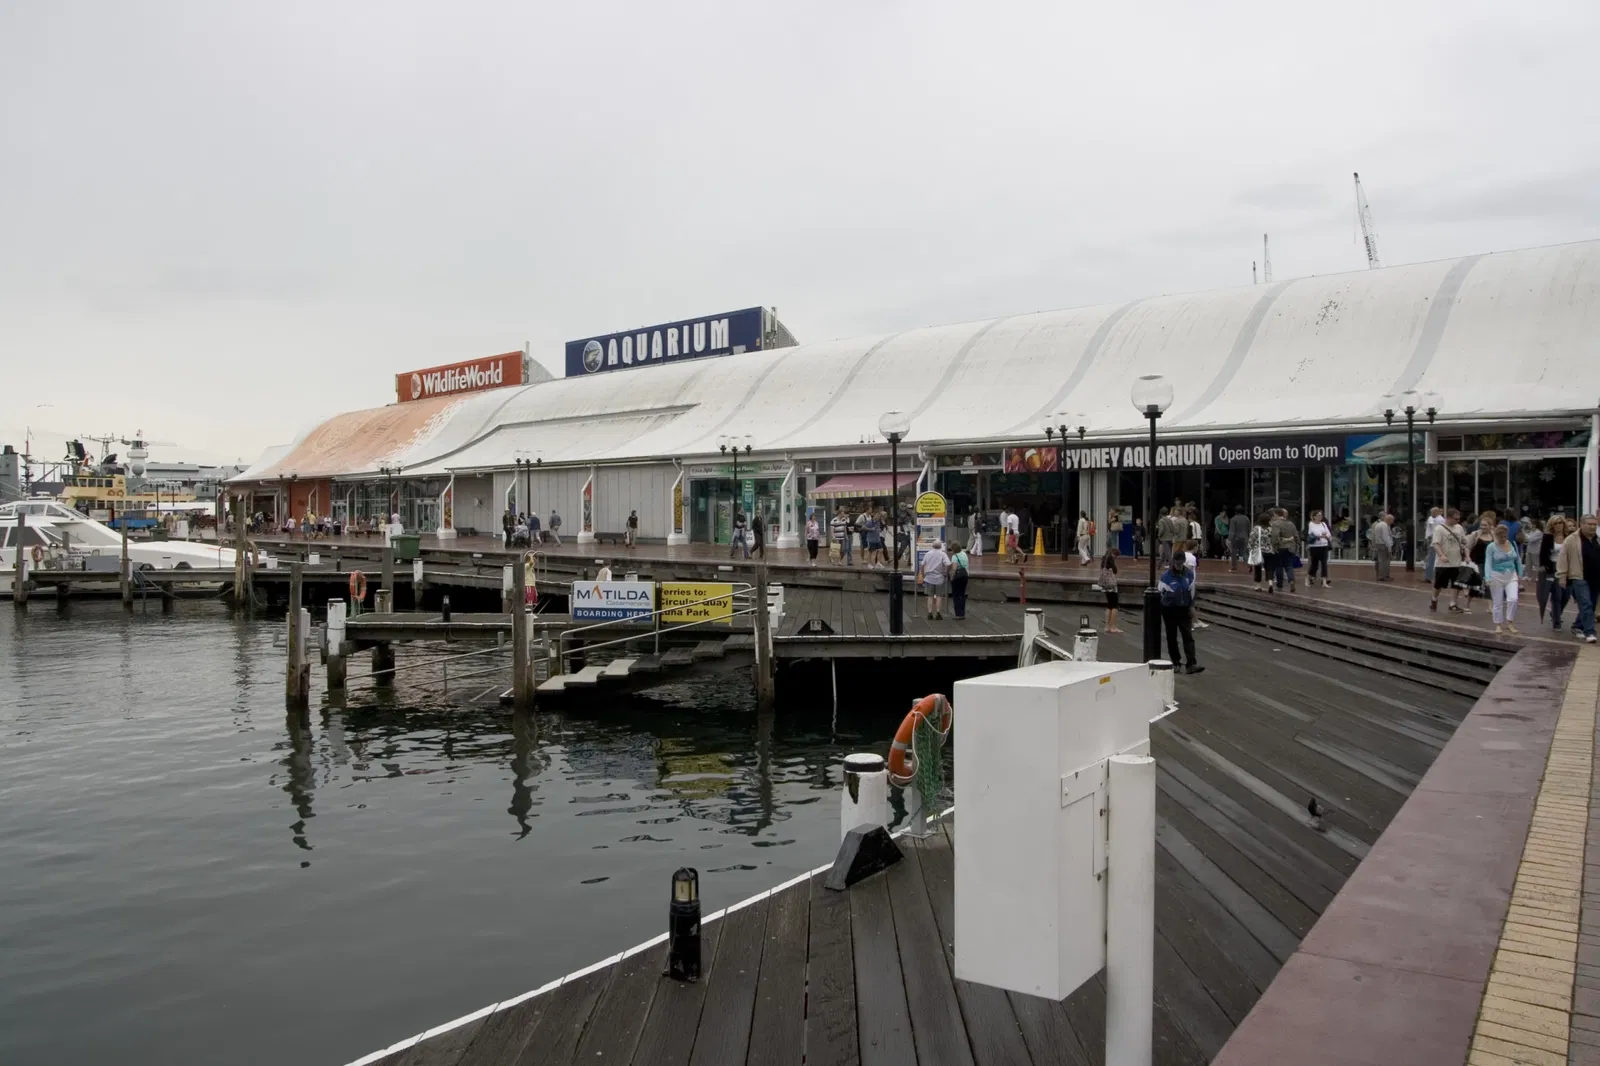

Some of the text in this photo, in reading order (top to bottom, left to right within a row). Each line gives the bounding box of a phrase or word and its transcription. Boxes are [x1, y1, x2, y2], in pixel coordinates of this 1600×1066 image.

[607, 318, 729, 366] AQUARIUM
[422, 360, 503, 395] WildlifeWorld
[1061, 443, 1213, 469] SYDNEY AQUARIUM
[1219, 444, 1339, 463] Open 9am to 10pm
[576, 584, 650, 601] MATILDA
[686, 608, 710, 616] Park
